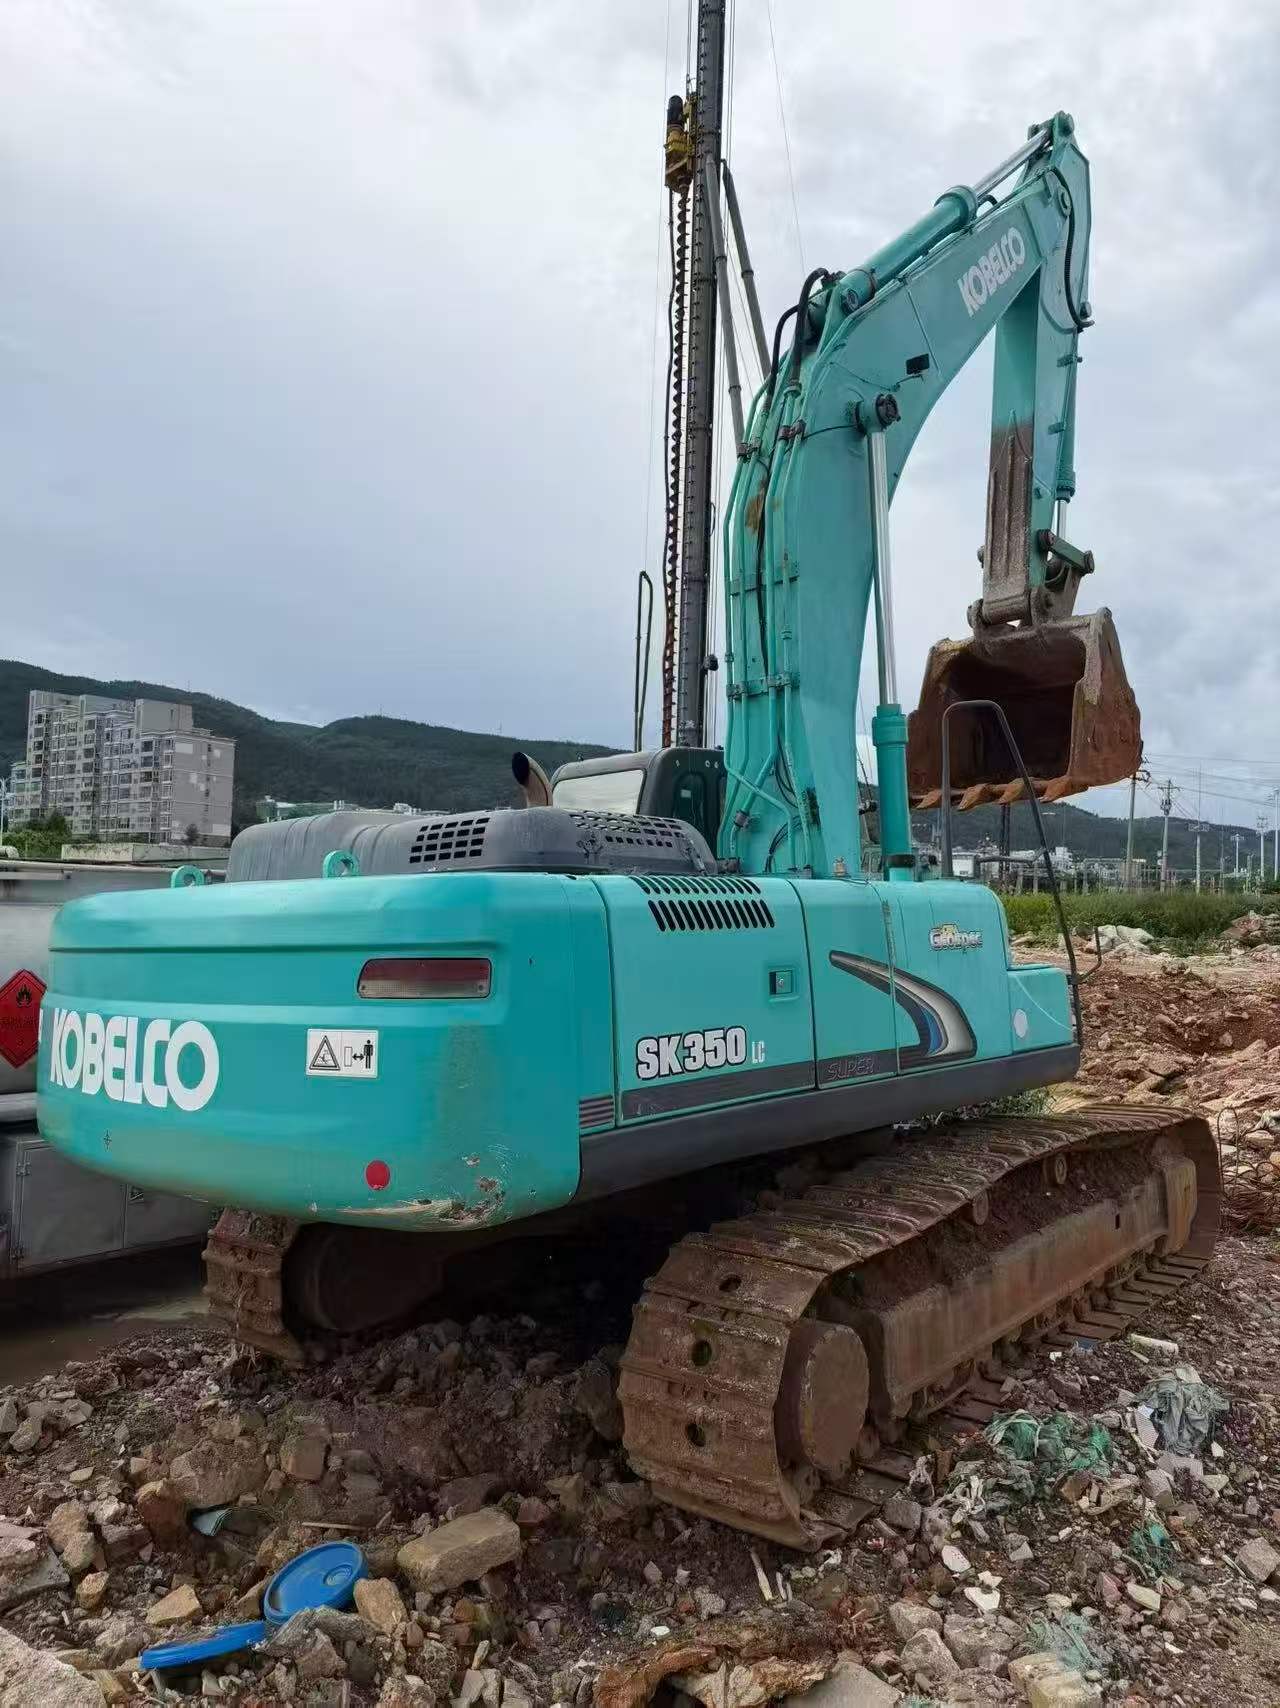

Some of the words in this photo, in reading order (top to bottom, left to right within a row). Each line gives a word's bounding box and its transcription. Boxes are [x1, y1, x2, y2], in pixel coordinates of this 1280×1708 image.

[957, 227, 1025, 318] KOBELCO
[50, 1007, 220, 1112] KOBELCO
[636, 1025, 747, 1080] SK350
[751, 1040, 766, 1064] LC
